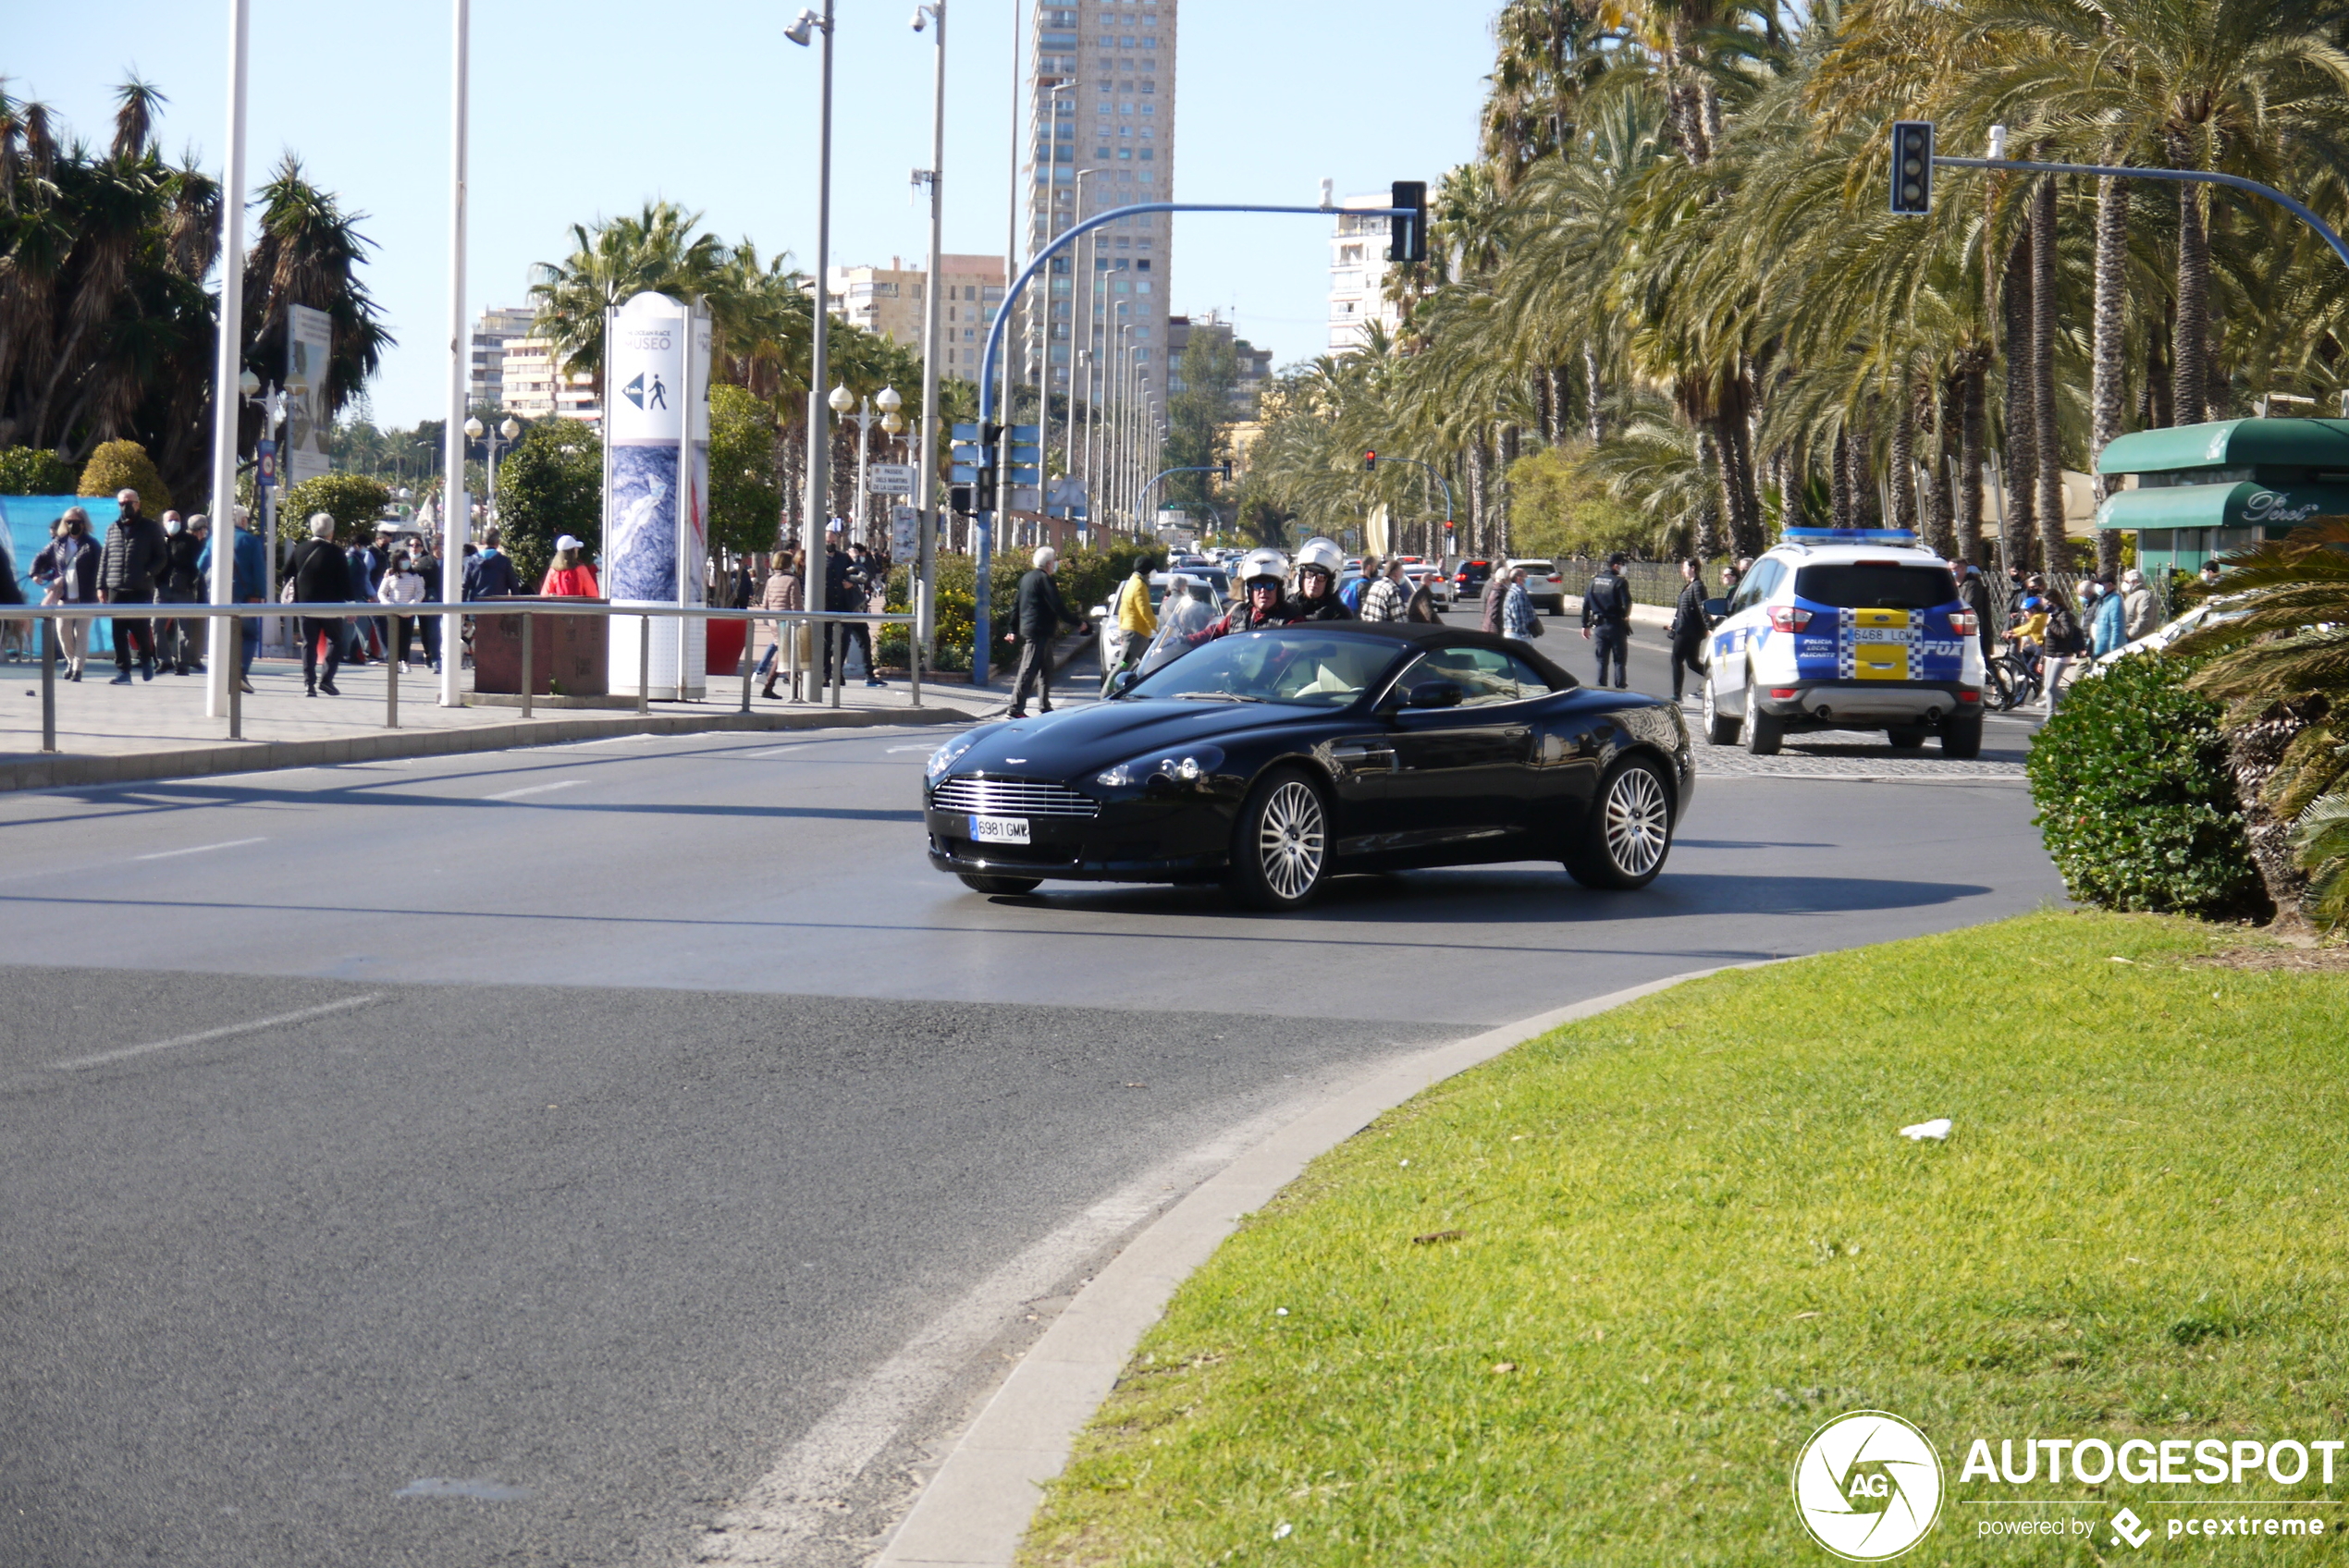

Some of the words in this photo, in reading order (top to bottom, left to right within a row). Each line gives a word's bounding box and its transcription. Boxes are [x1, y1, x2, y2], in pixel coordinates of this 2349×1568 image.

[625, 337, 671, 350] MUSEO
[1854, 630, 1883, 640] 6468
[1891, 631, 1913, 642] LCM
[1922, 640, 1964, 655] FOX
[978, 821, 1004, 836] 6981
